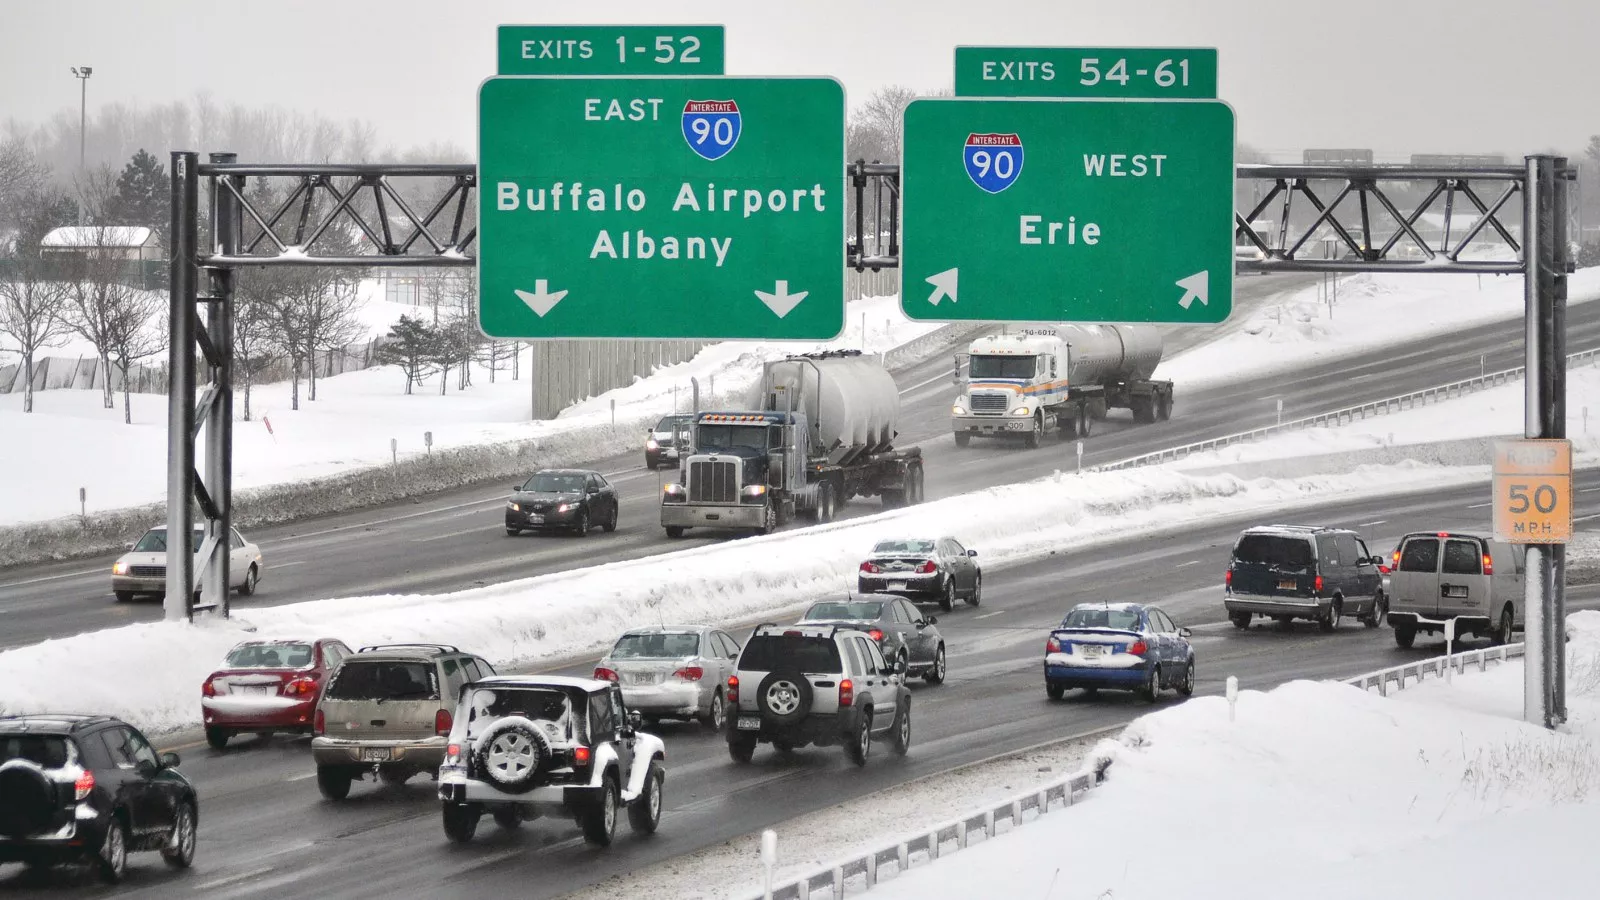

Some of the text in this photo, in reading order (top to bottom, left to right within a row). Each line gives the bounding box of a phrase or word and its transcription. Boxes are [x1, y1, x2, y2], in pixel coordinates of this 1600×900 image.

[521, 36, 701, 63] EXITS 1-52
[982, 58, 1190, 87] EXITS 54-61
[584, 99, 664, 121] EAST
[690, 103, 731, 112] INTERSTATE
[692, 118, 733, 146] 90
[972, 136, 1014, 145] INTERSTATE
[972, 151, 1014, 179] 90
[1083, 154, 1167, 177] WEST
[497, 182, 826, 218] Buffalo Airport
[1019, 216, 1102, 245] Erie
[589, 230, 732, 267] Albany
[1506, 448, 1558, 464] RAMP
[1508, 484, 1557, 514] 50
[1513, 522, 1551, 533] MPH
